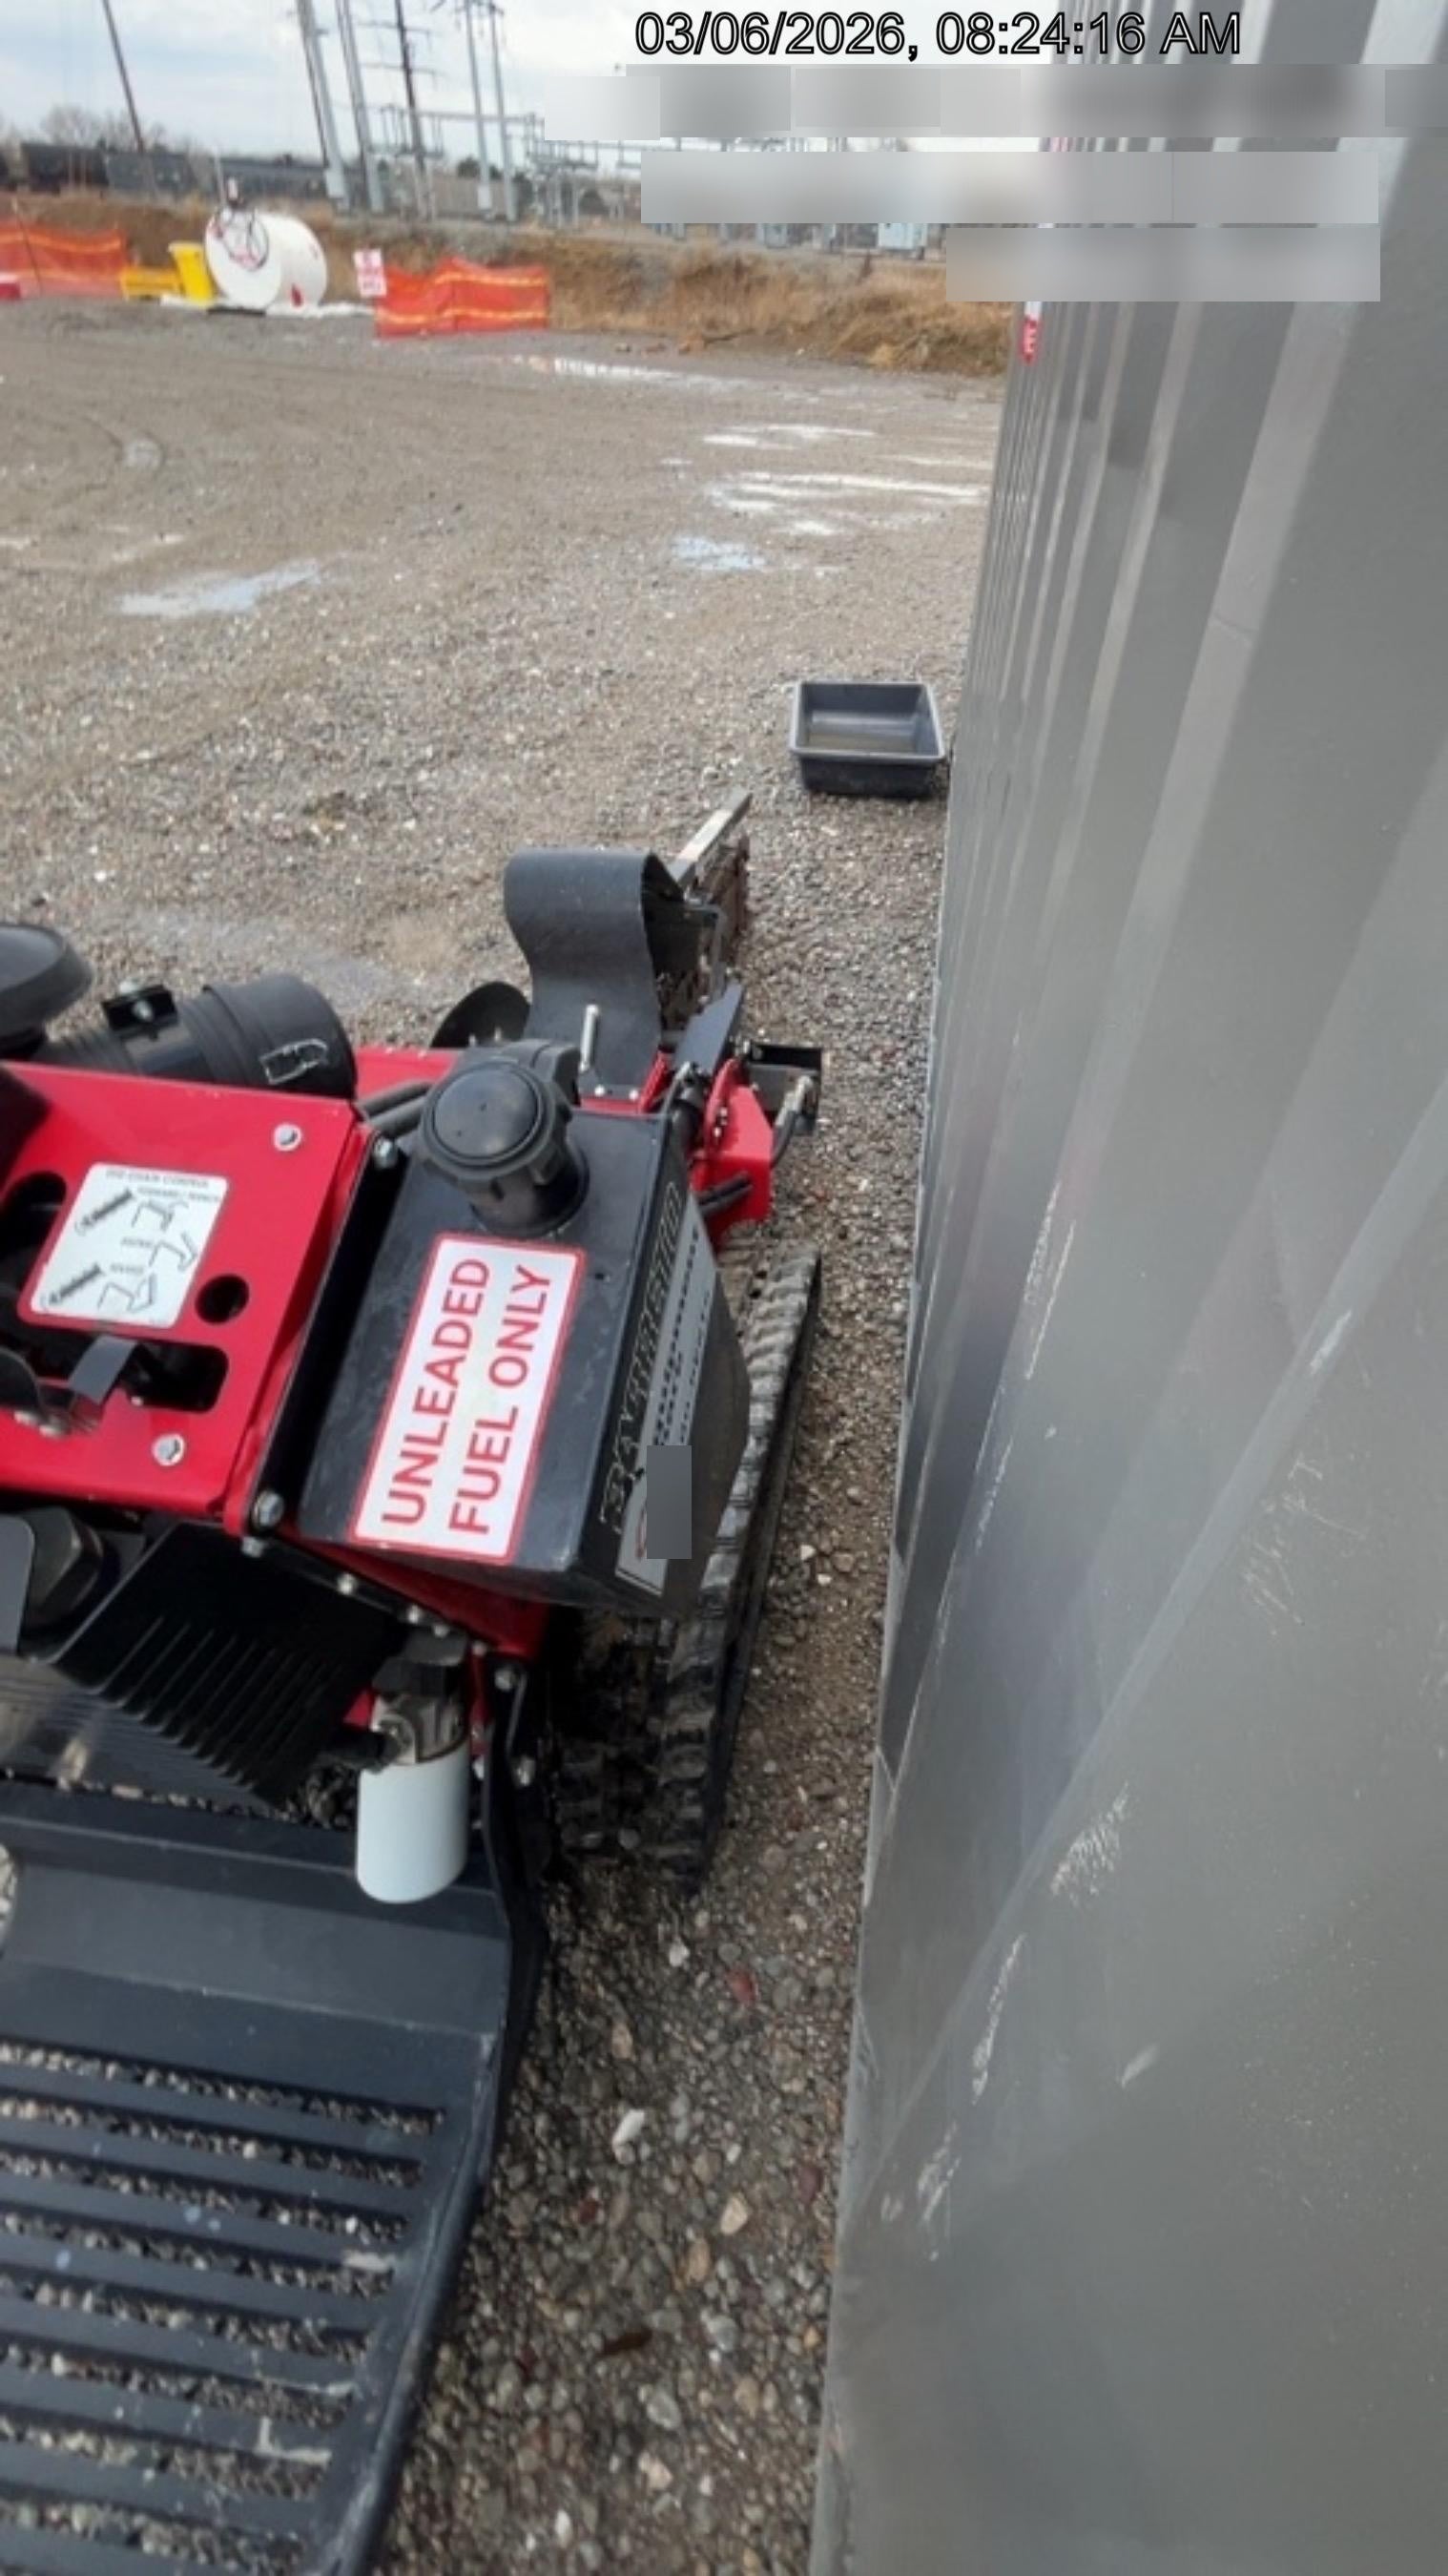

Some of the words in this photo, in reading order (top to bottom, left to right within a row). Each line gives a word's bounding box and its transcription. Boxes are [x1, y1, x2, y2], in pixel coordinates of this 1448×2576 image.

[381, 1257, 489, 1525] UNLEADED
[448, 1405, 519, 1534] FUEL
[487, 1264, 551, 1388] ONLY
